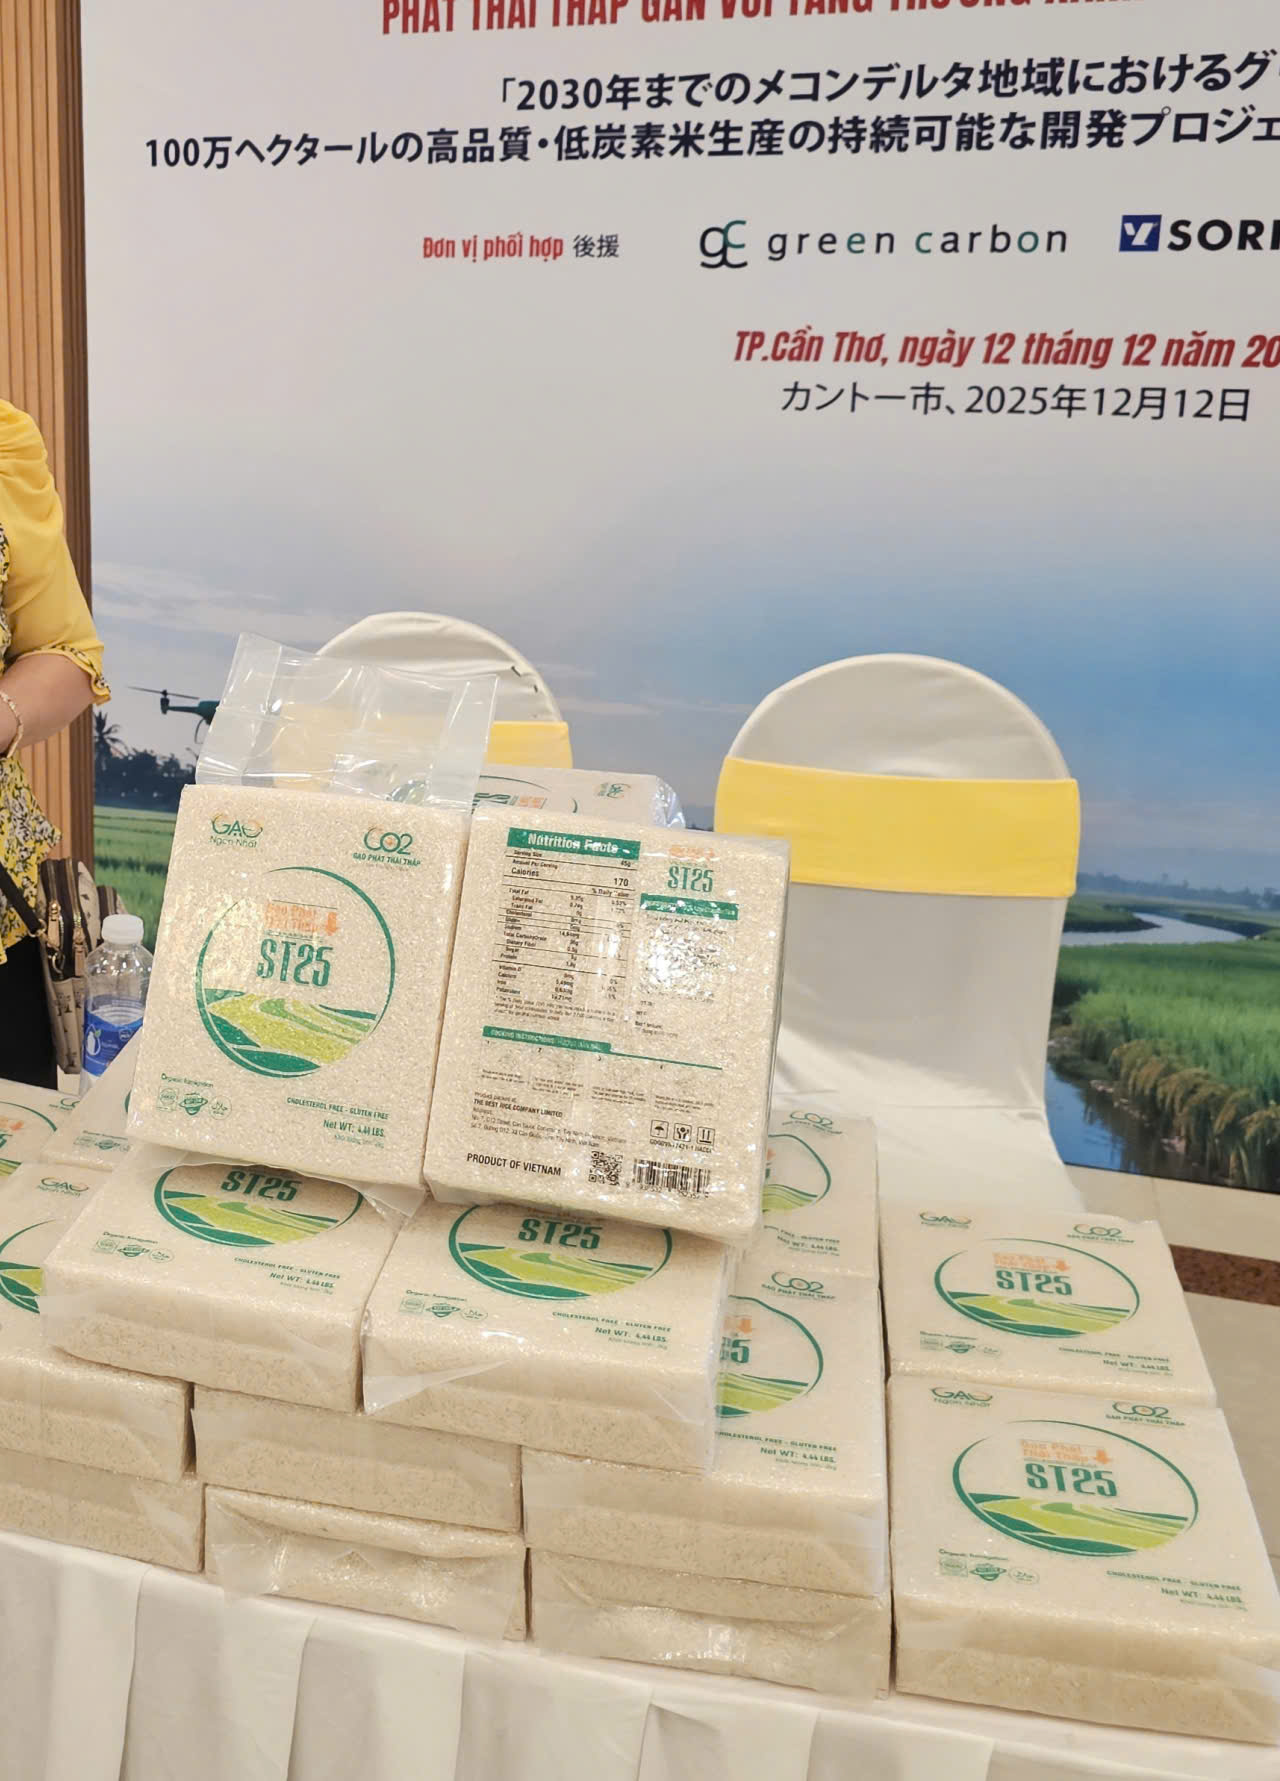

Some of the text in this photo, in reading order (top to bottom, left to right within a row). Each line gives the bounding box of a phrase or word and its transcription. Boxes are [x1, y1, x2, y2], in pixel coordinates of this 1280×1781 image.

[423, 231, 619, 262] Đơn vị phối hợp 後援
[768, 224, 1067, 261] green carbon
[734, 325, 824, 362] TP.Cần
[832, 331, 888, 366] Thơ,
[898, 328, 975, 367] ngày
[982, 333, 1016, 364] 12
[1021, 329, 1114, 369] tháng
[1122, 334, 1157, 366] 12
[1161, 331, 1236, 368] năm
[781, 380, 1250, 422] カントー市、2025年12月12日
[364, 826, 413, 855] CO2
[528, 832, 581, 849] Nutrition
[511, 867, 629, 887] Calories 170
[668, 866, 714, 892] ST25
[256, 938, 333, 987] ST25
[287, 1097, 327, 1109] CHOLESTEROL
[467, 1153, 562, 1176] PRODUCT OF VIETNAM
[221, 1170, 302, 1202] ST25
[518, 1218, 603, 1251] ST25
[1073, 1223, 1122, 1237] CO2
[771, 1271, 824, 1294] CO2
[995, 1269, 1072, 1296] ST25
[1112, 1401, 1172, 1419] CO2
[1025, 1463, 1117, 1497] ST25
